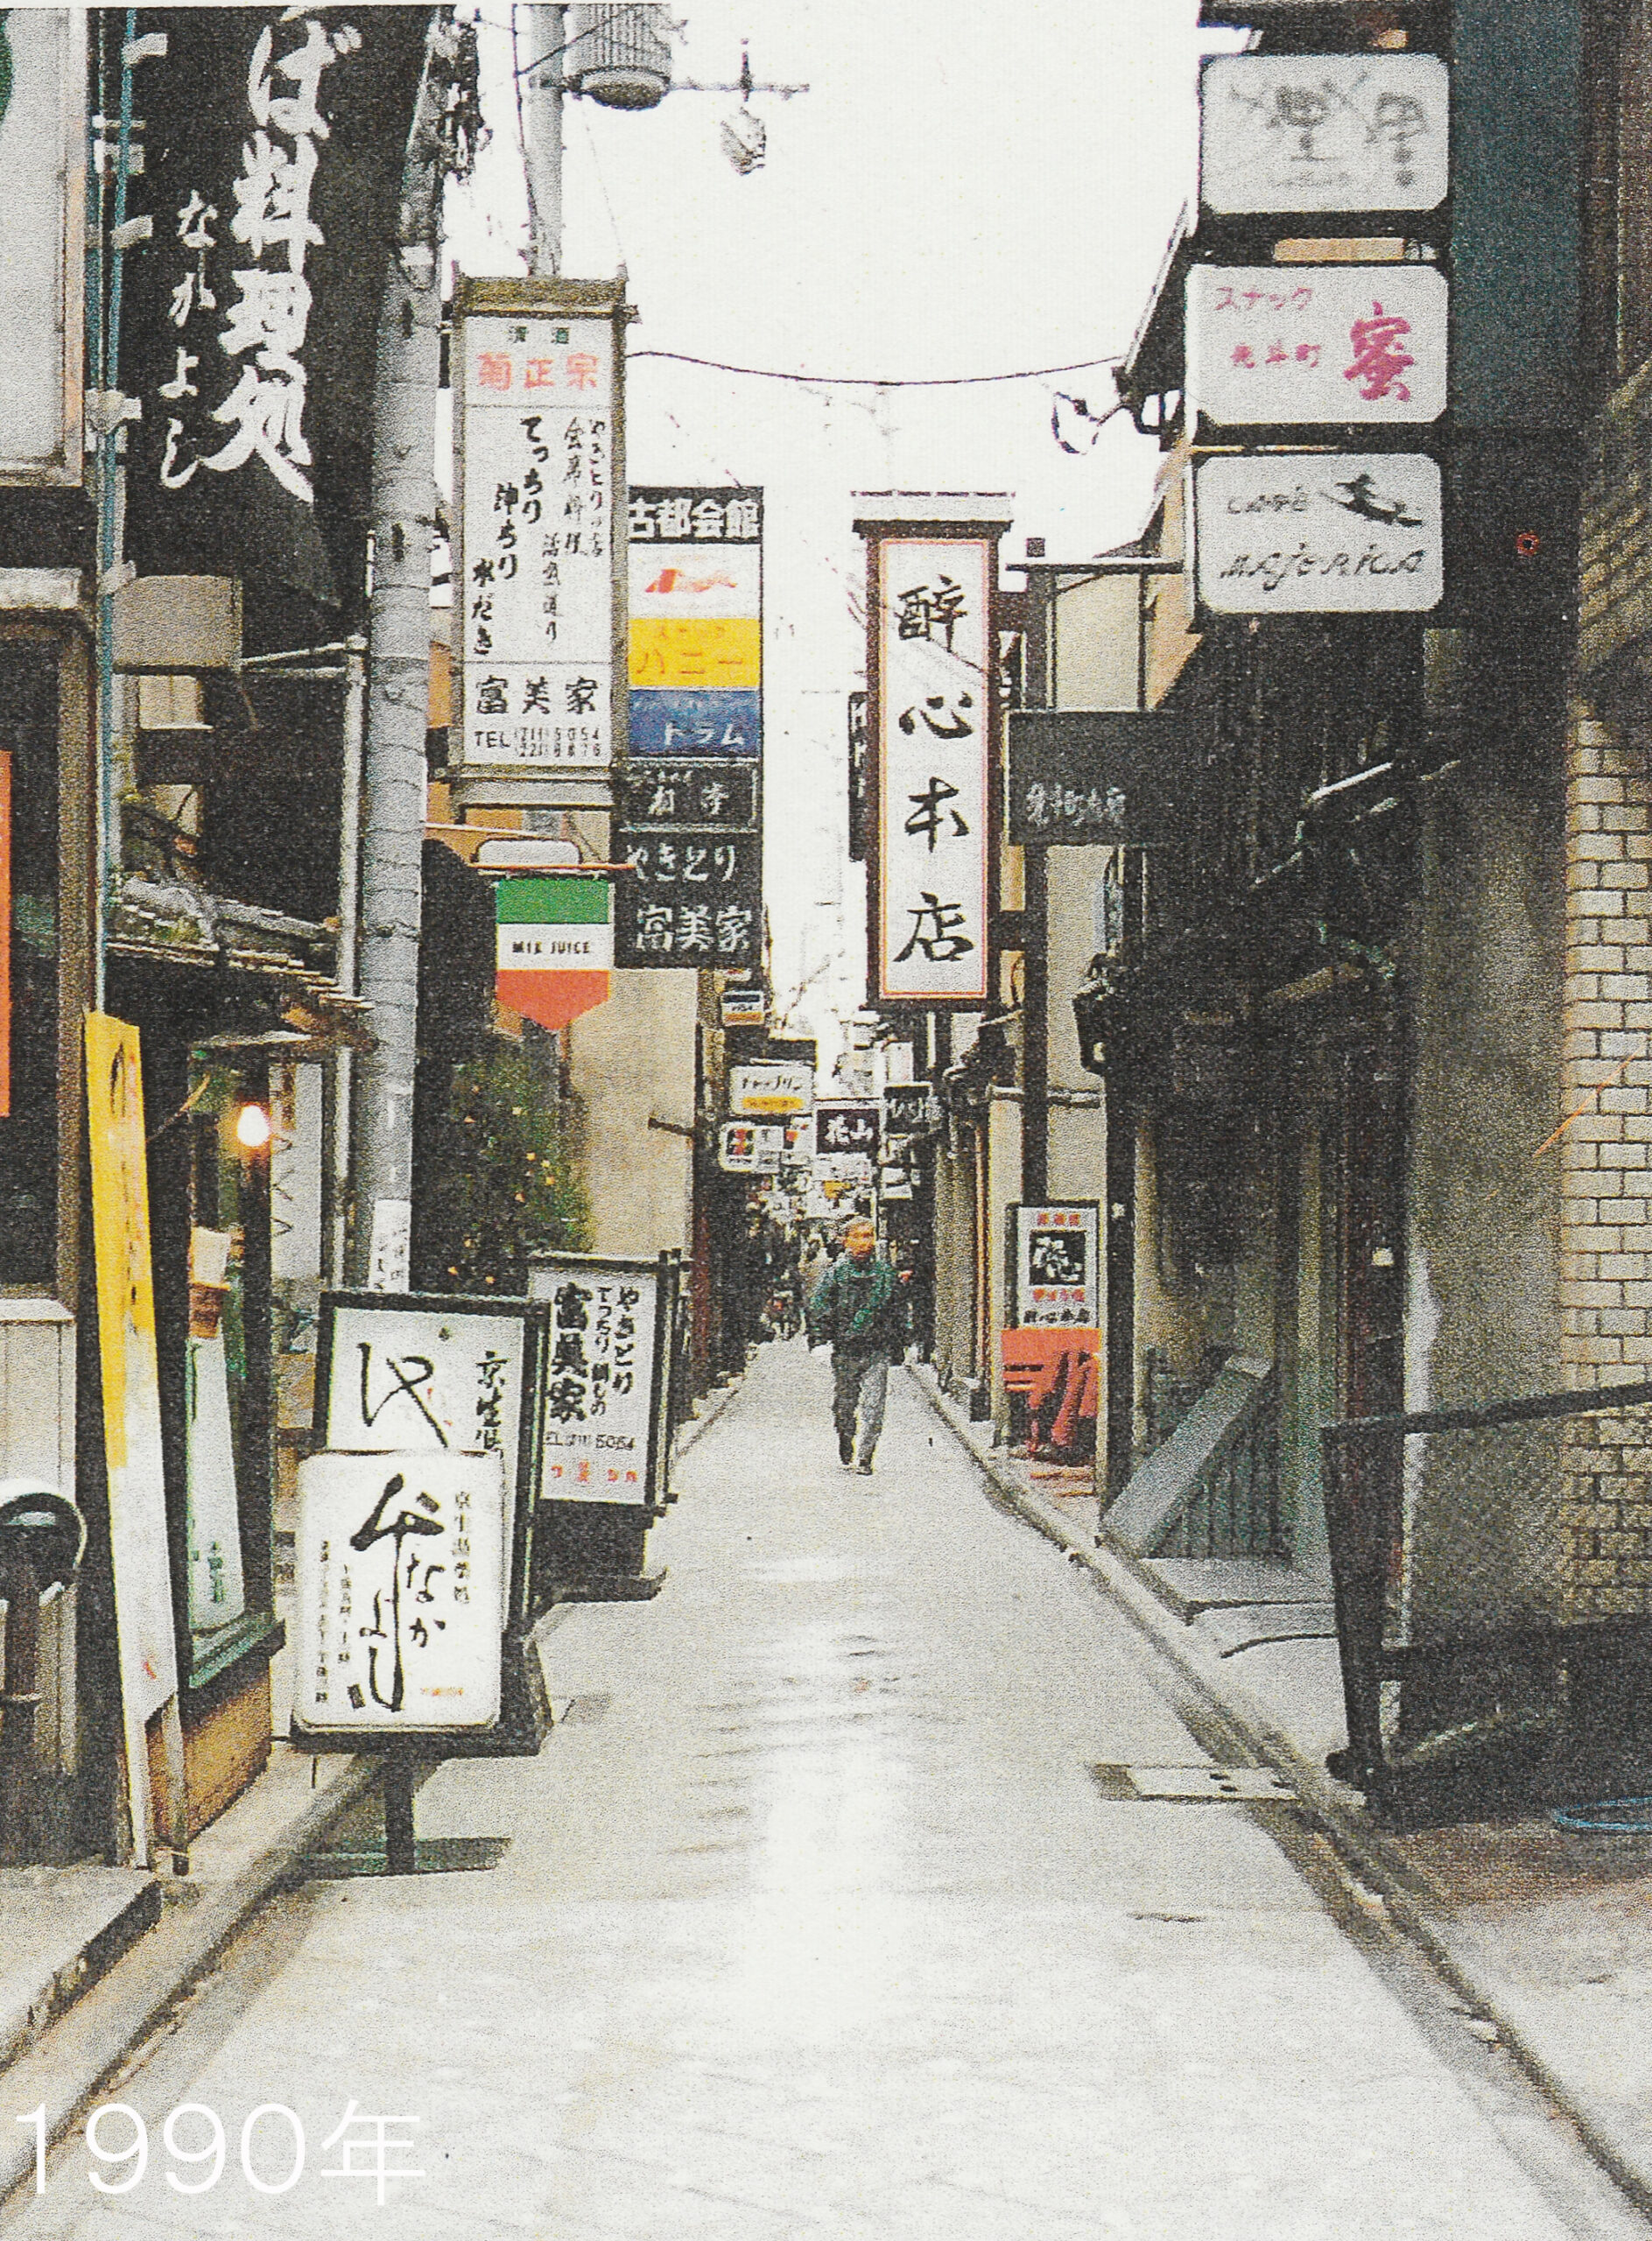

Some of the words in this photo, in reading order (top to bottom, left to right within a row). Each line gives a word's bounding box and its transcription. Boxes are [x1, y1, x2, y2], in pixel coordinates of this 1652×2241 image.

[1213, 286, 1313, 311] スナック
[159, 188, 220, 489] なかよし
[476, 351, 601, 392] 菊正宗
[628, 496, 760, 539] 古都会館
[635, 648, 745, 676] ハニー
[475, 674, 600, 716] 富美家
[473, 729, 511, 750] TEL
[664, 720, 744, 747] トラム
[624, 842, 737, 882] やきとり
[549, 939, 592, 955] JUICE
[634, 903, 753, 952] 富美家
[611, 1285, 640, 1396] やきとり
